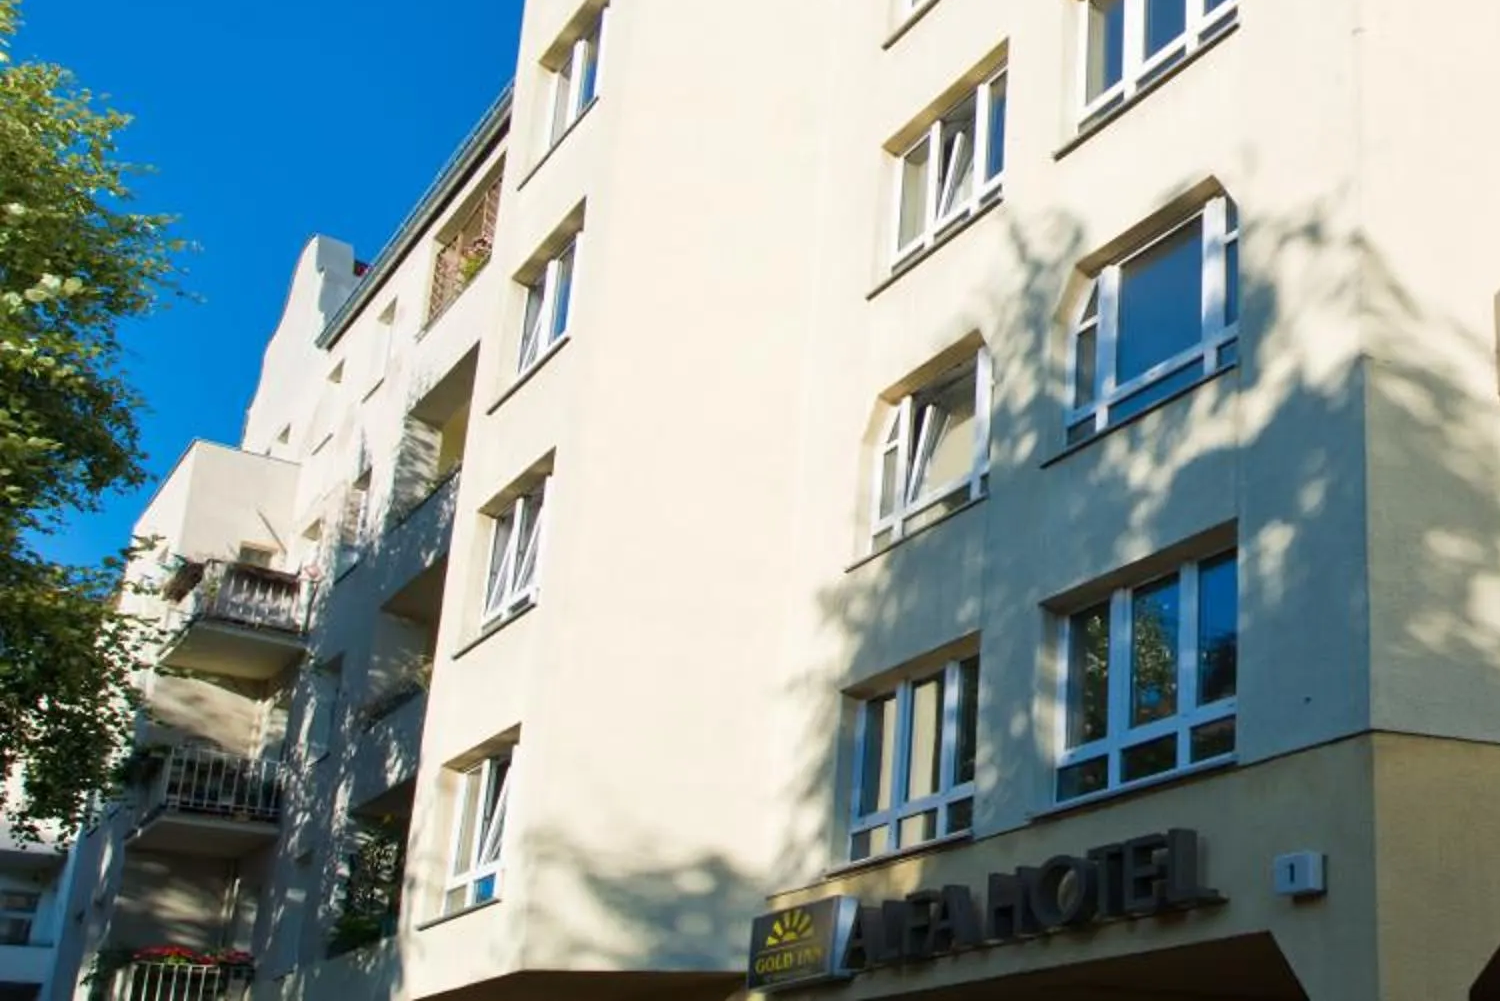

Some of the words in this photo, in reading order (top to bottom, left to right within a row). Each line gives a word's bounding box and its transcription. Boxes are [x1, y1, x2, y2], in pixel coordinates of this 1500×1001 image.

[842, 884, 978, 966] ALFA
[986, 828, 1218, 941] HOTEL
[755, 950, 792, 974] GOLD
